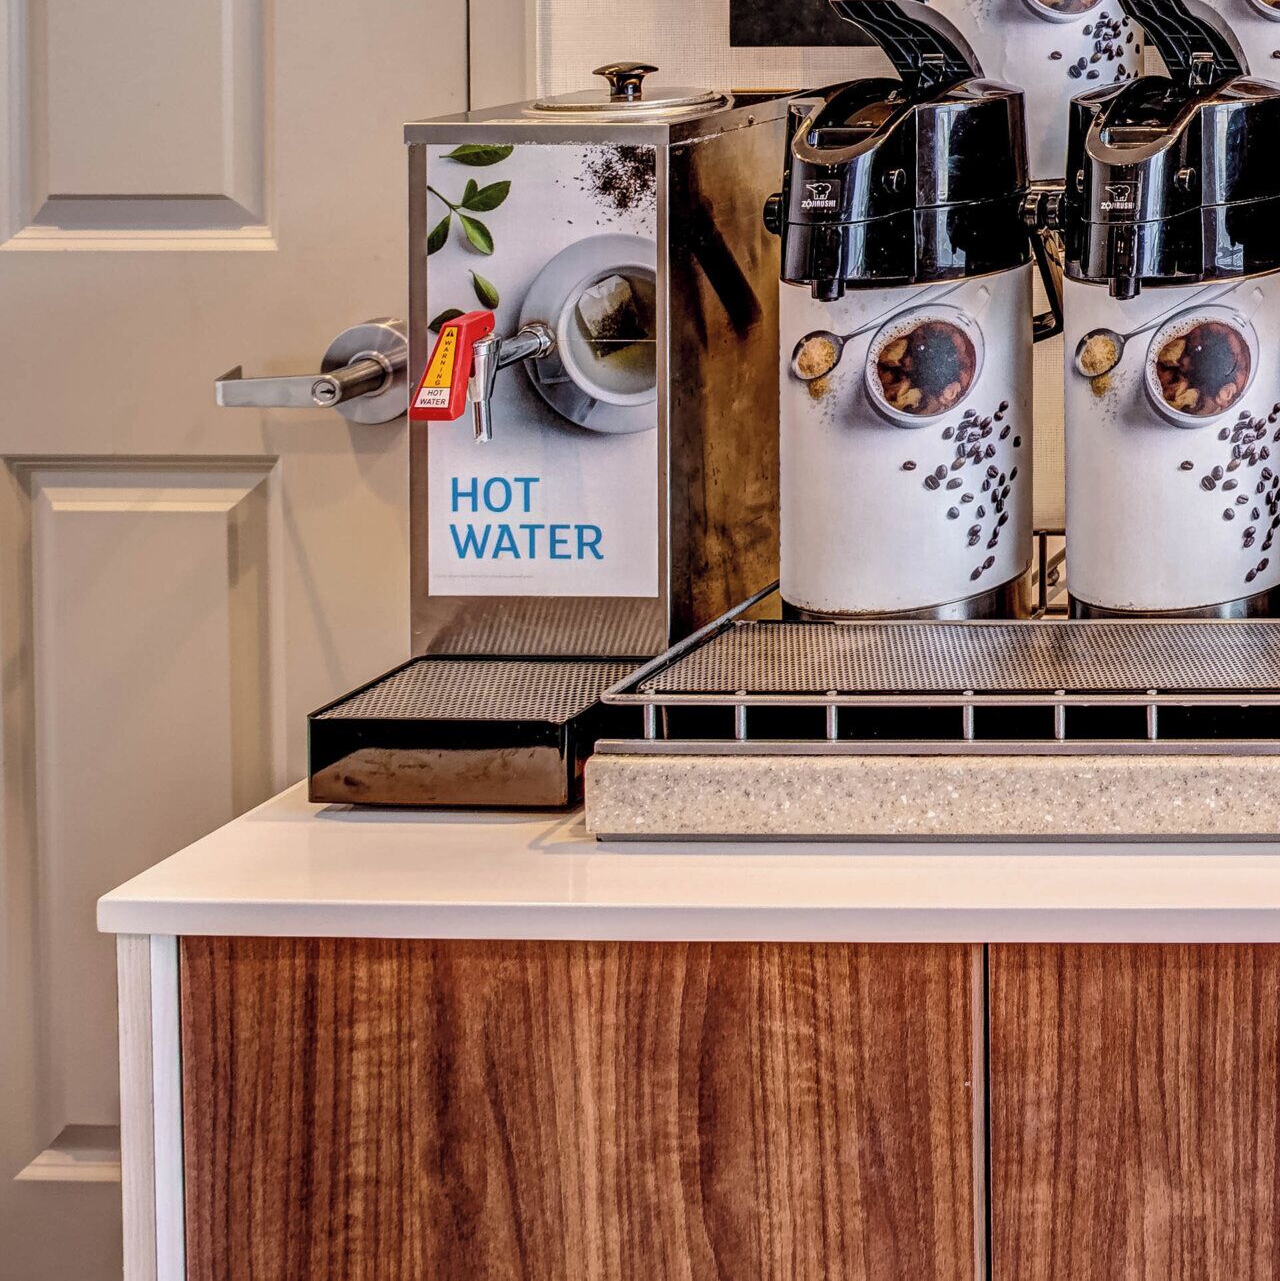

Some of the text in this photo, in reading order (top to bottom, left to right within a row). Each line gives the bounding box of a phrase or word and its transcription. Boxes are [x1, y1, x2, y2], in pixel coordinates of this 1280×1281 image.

[801, 198, 837, 209] ZOJIRUSHI
[1100, 200, 1135, 211] ZOJIRUSHI
[434, 340, 452, 386] WARNING
[427, 389, 444, 397] HOT
[419, 398, 446, 406] WATER
[451, 476, 541, 513] HOT
[449, 524, 604, 560] WATER
